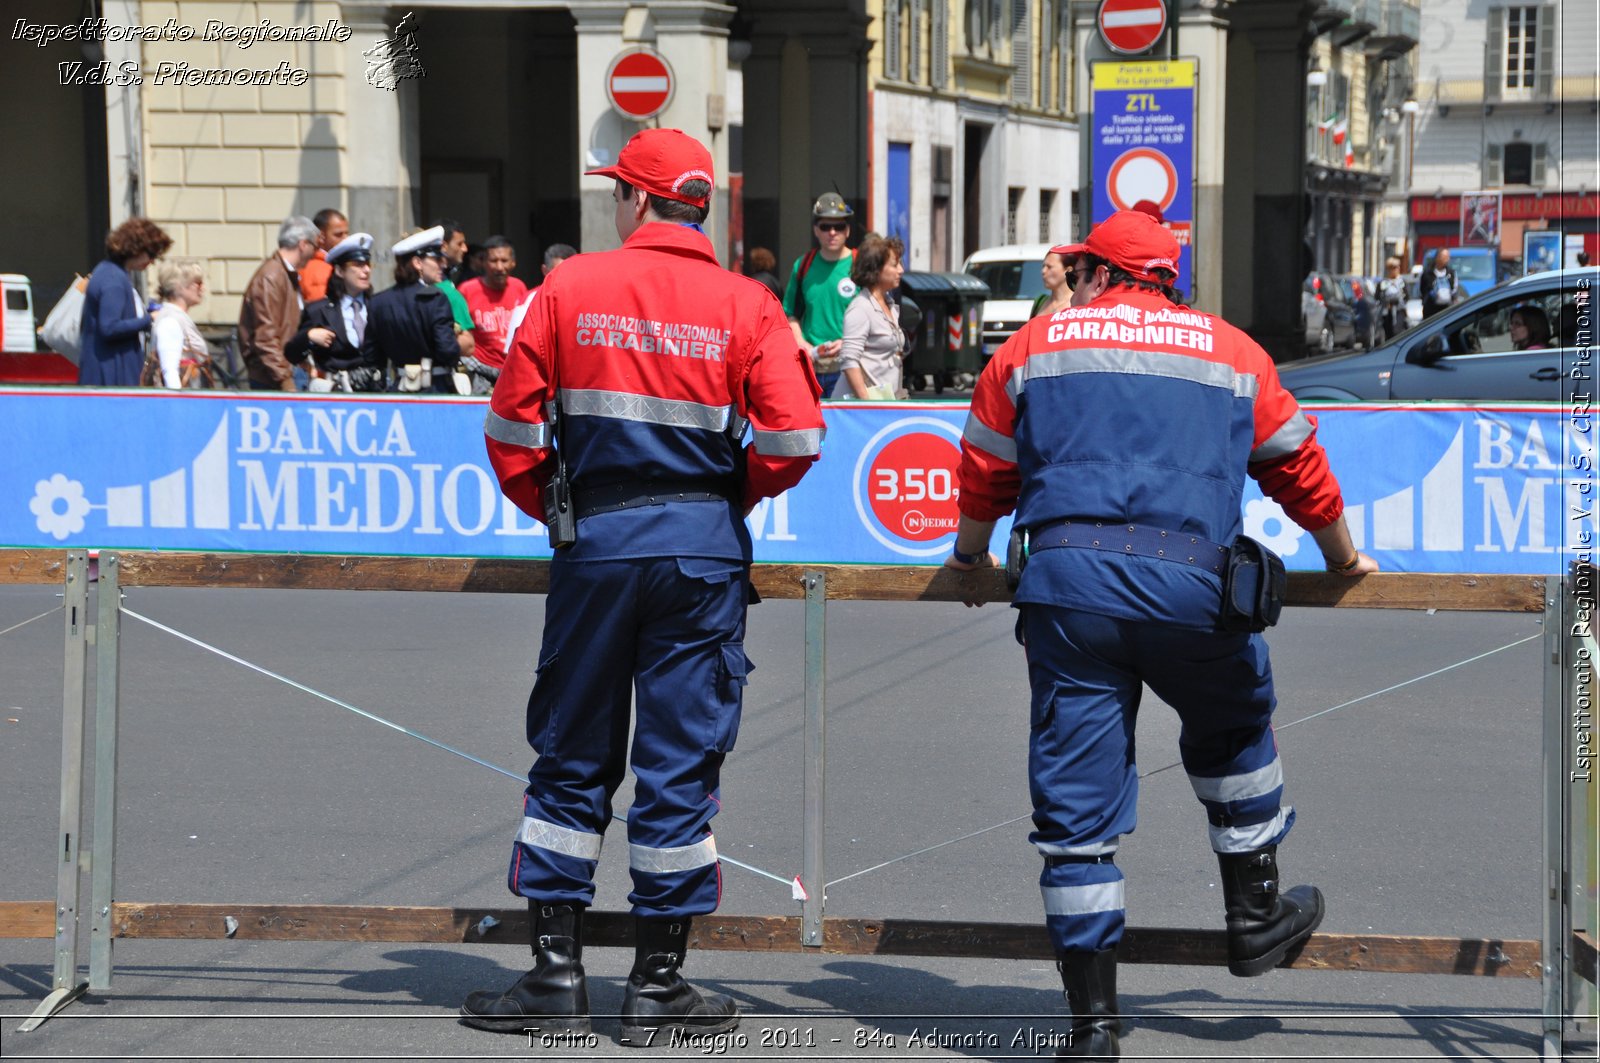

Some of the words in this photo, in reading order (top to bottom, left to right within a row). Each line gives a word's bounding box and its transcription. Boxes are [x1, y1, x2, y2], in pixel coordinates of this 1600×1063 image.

[1116, 77, 1129, 86] Via
[1125, 93, 1161, 112] ZTL
[1112, 114, 1145, 124] Traffico
[1146, 113, 1175, 123] vietato
[1101, 125, 1115, 135] dal
[1102, 135, 1123, 145] dalle
[1144, 134, 1159, 144] alle
[1418, 200, 1460, 216] BERG
[1050, 303, 1142, 325] ASSOCIAZIONE
[1144, 308, 1213, 331] NAZIONALE
[577, 313, 662, 336] ASSOCIAZIONE
[664, 322, 731, 345] NAZIONALE
[1047, 321, 1213, 352] CARABINIERI
[576, 329, 728, 362] CARABINIERI
[236, 406, 416, 457] BANCA
